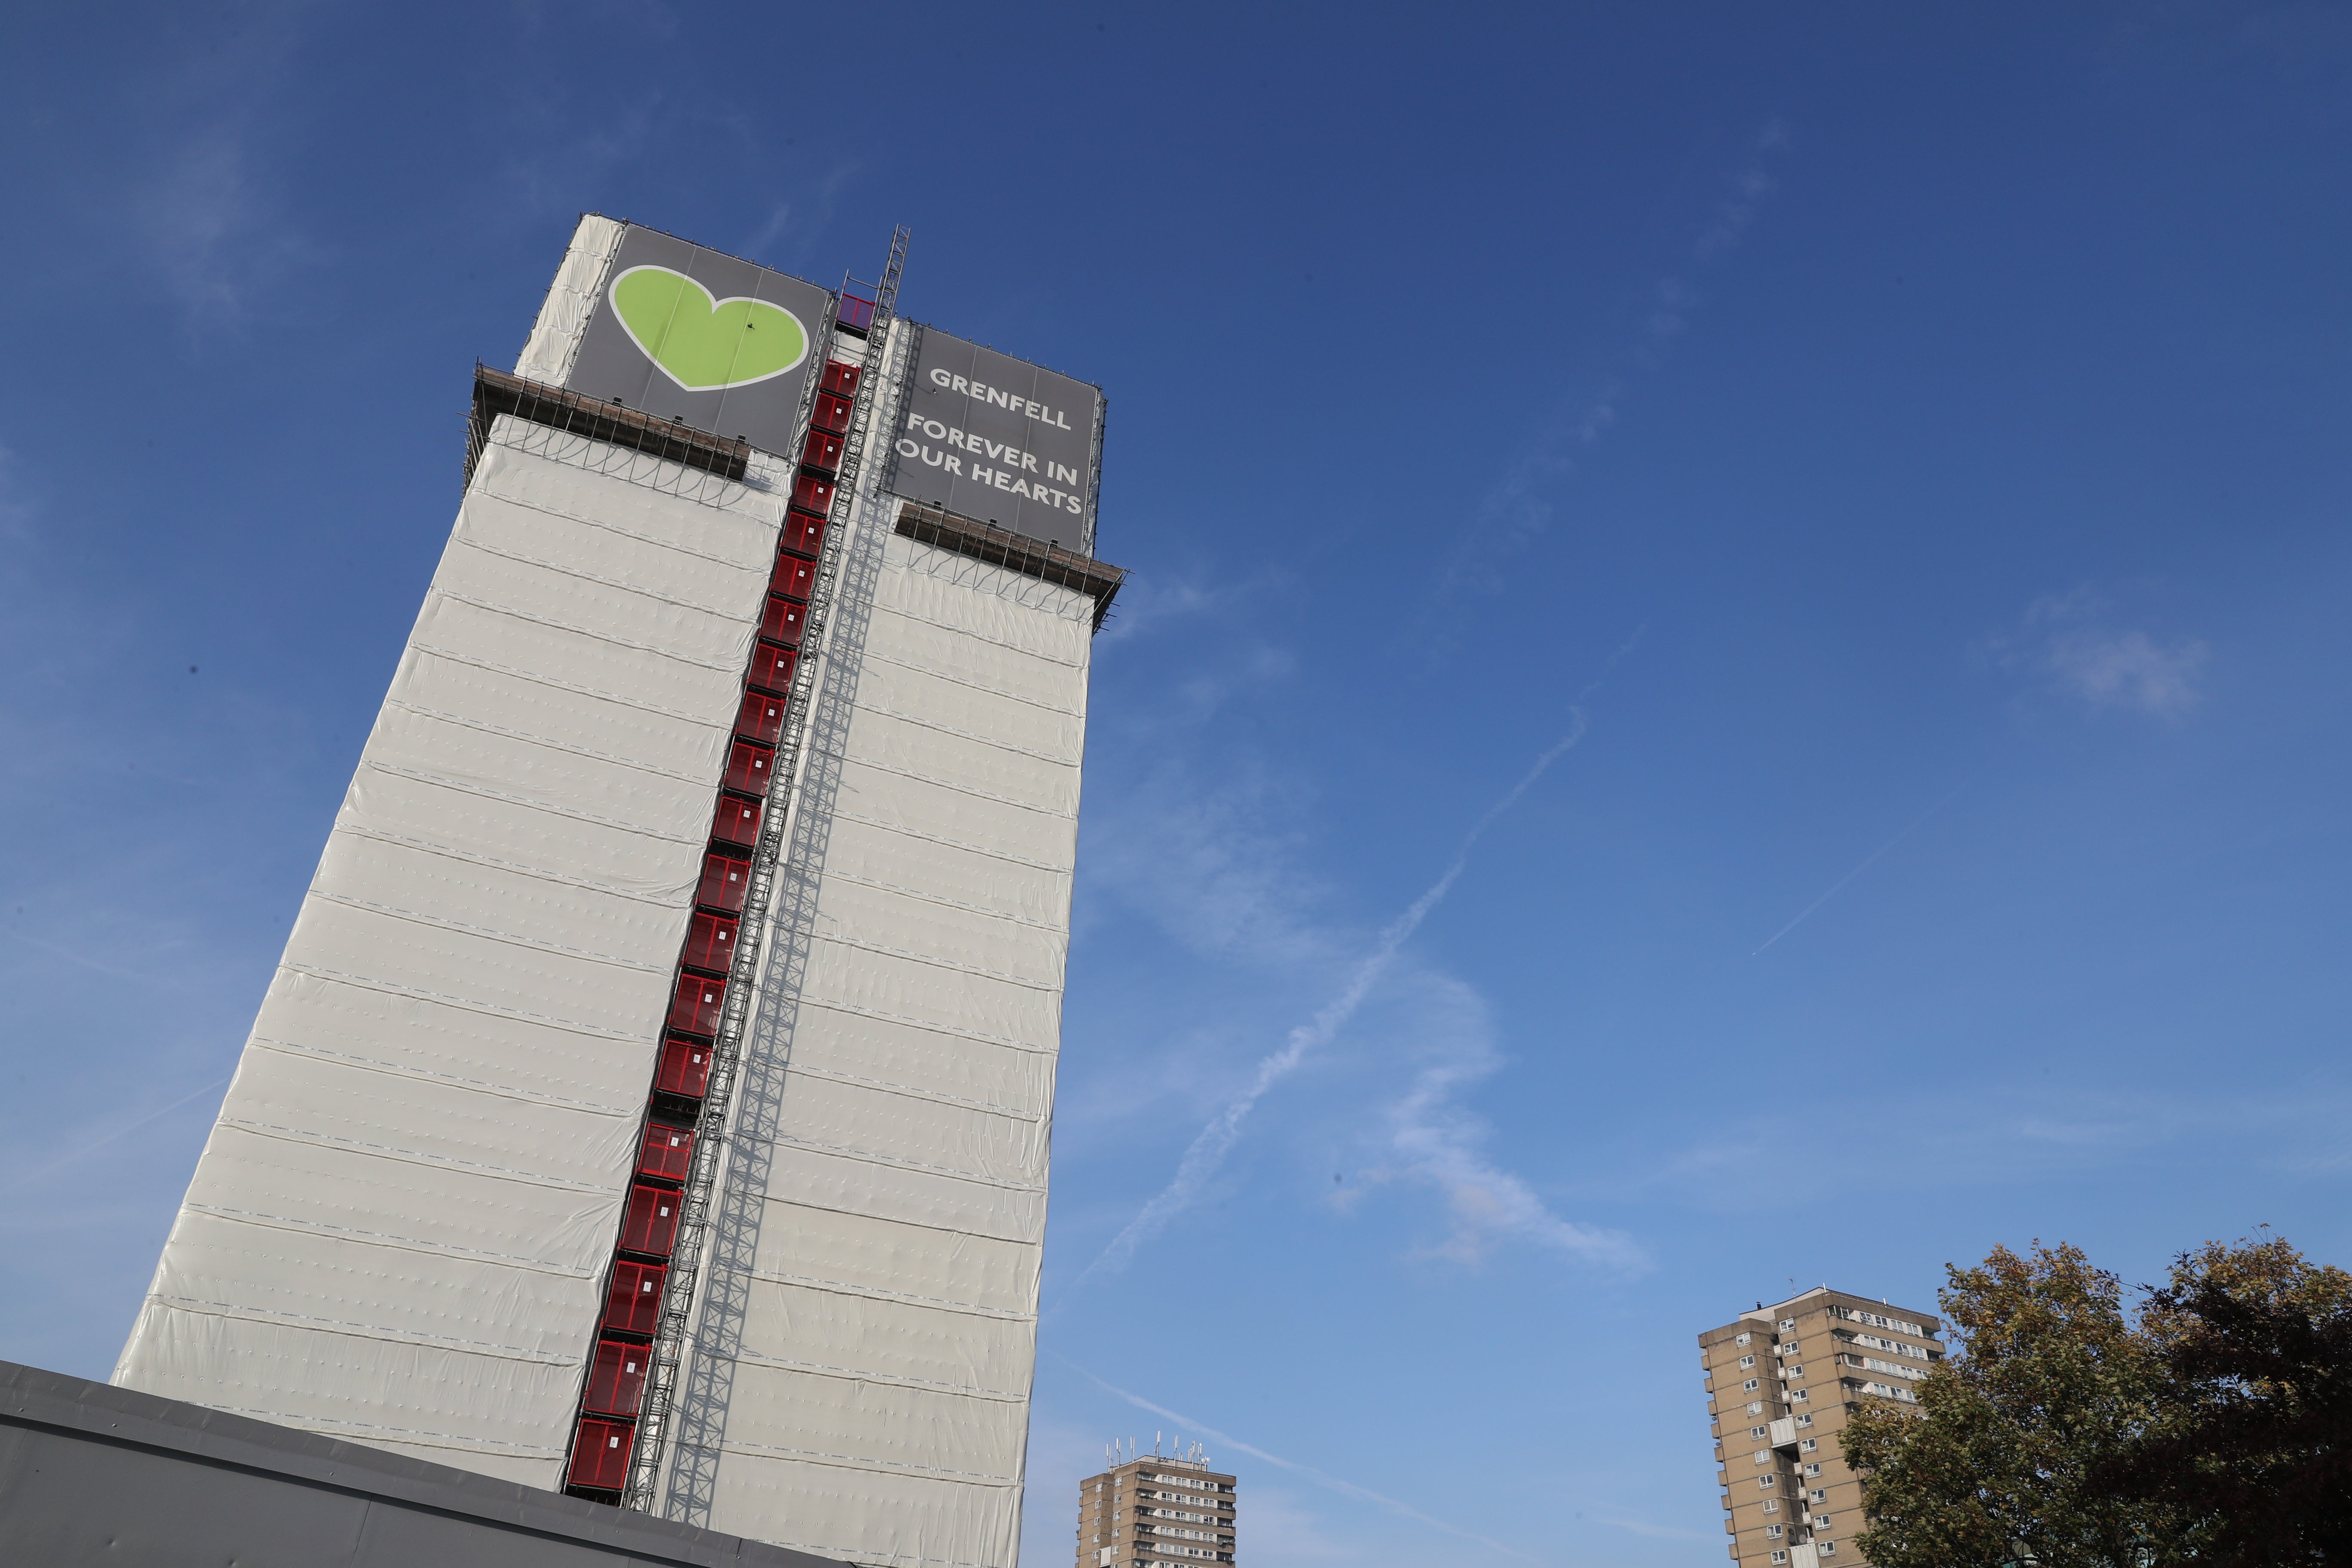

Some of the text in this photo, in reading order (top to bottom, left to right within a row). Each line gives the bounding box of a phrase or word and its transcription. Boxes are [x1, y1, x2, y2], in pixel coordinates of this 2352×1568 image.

[930, 368, 1071, 431] GRENFELL
[895, 438, 1081, 514] OUR HEARTS
[907, 412, 1077, 486] FOREVER IN
